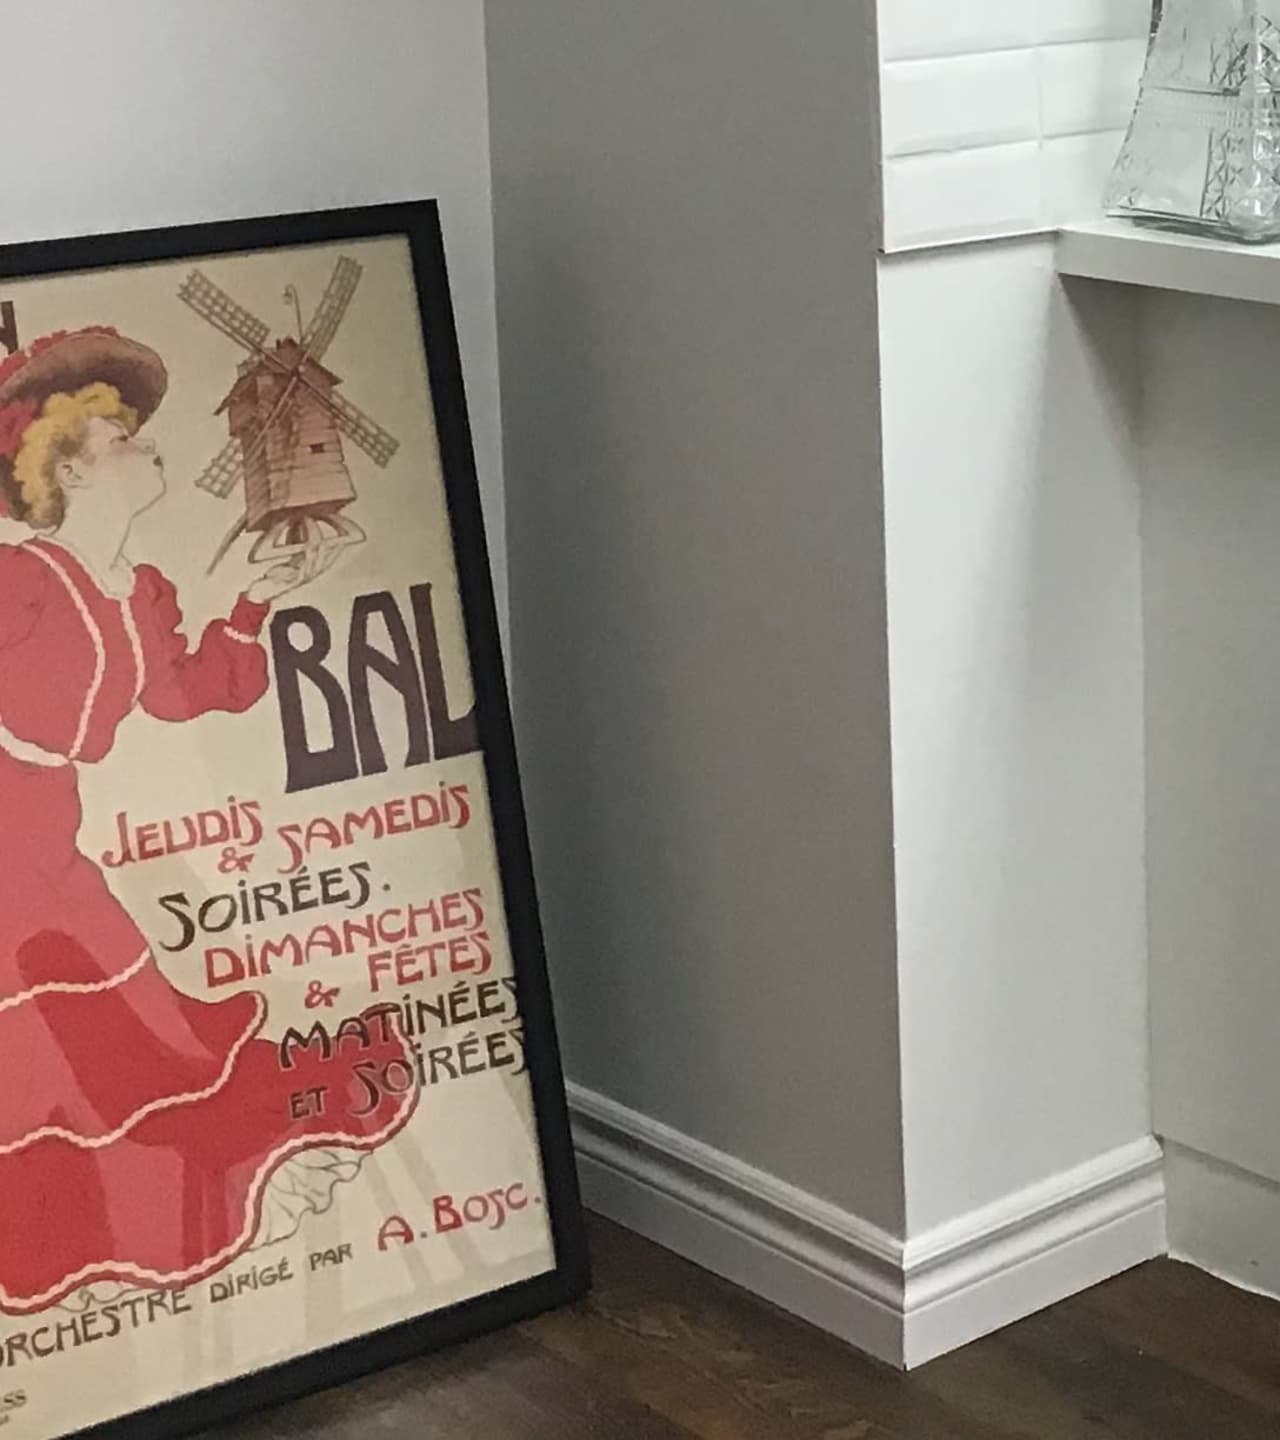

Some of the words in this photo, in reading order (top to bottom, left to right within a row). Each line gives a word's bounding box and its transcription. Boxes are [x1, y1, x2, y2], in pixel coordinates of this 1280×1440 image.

[270, 582, 485, 794] BAL
[102, 795, 263, 869] JEUDIS
[217, 846, 256, 874] &
[277, 781, 471, 875] SAMEDIS
[204, 888, 485, 988] DIMANCHES
[304, 980, 341, 1009] &
[289, 1086, 328, 1120] ET
[0, 1288, 192, 1368] RCHESTRE
[209, 1258, 293, 1304] DIRIGÉ
[309, 1243, 354, 1271] PAR
